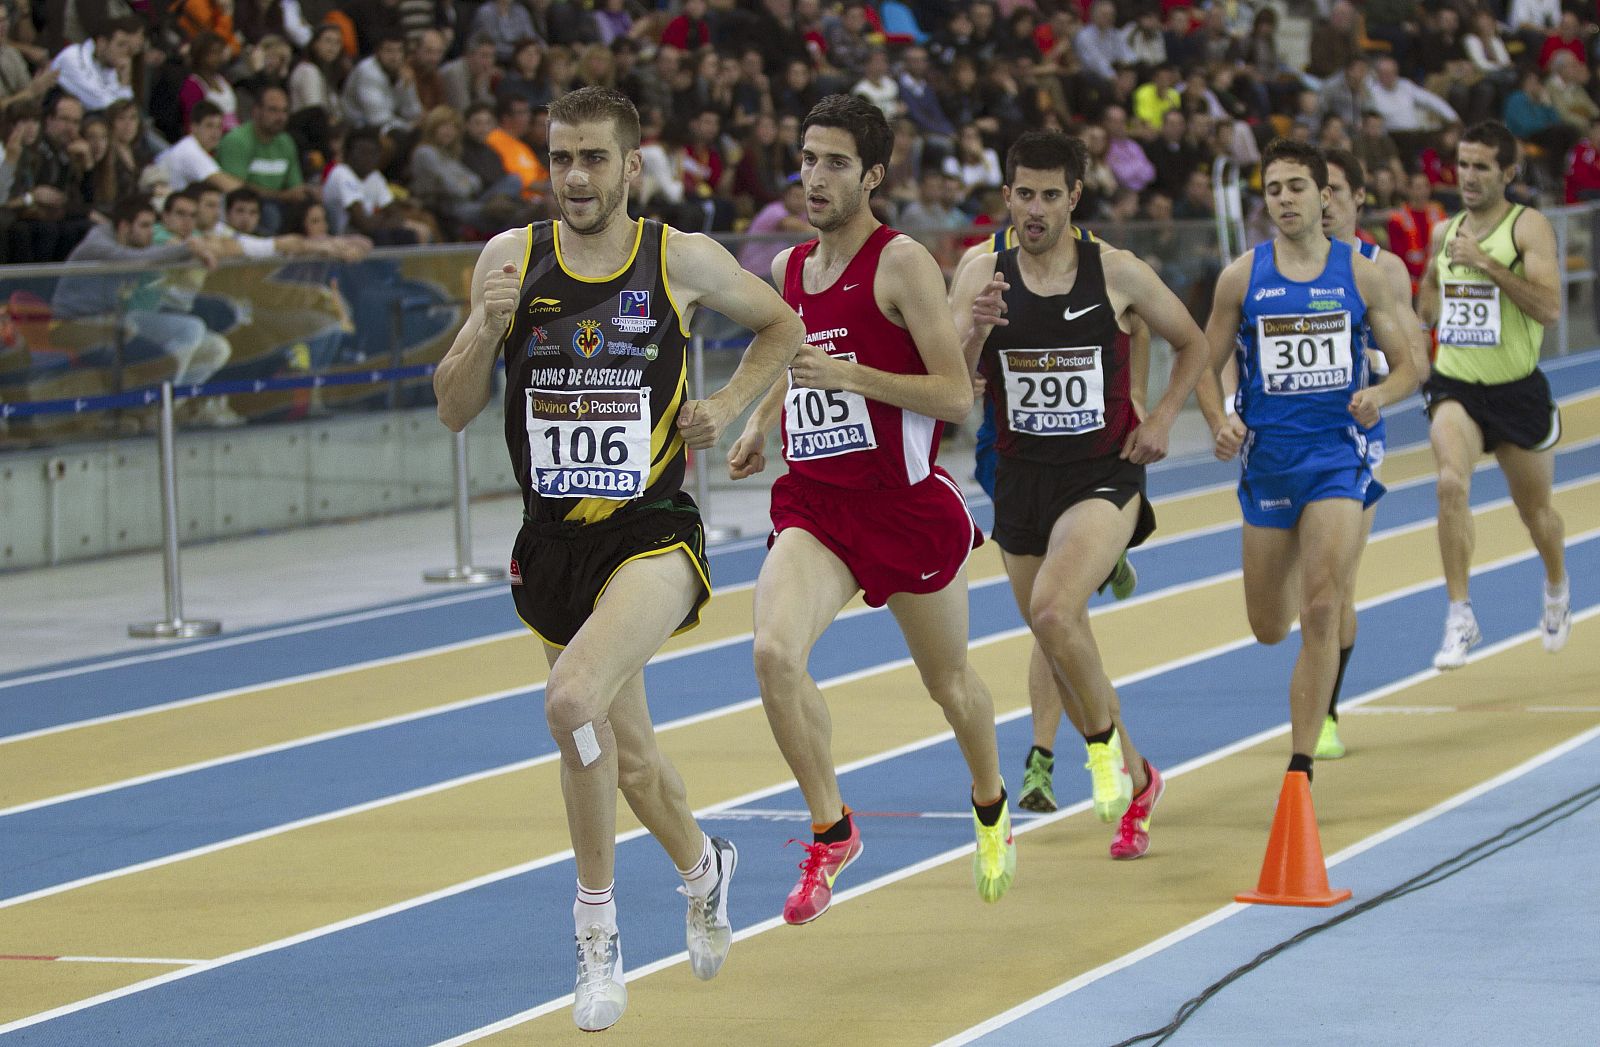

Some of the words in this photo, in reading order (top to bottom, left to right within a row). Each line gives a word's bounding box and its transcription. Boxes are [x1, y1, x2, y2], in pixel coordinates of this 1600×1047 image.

[1265, 287, 1287, 298] asics
[529, 306, 561, 314] LI-NING
[1446, 302, 1489, 326] 239
[1311, 319, 1345, 331] Pastora
[1009, 357, 1037, 368] Divina
[1057, 355, 1094, 367] Pastora
[1275, 338, 1336, 369] 301
[531, 367, 566, 386] PLAYAS
[567, 368, 583, 386] DE
[584, 368, 643, 387] CASTELLON
[1017, 375, 1088, 409] 290
[533, 399, 568, 414] Divina
[590, 400, 639, 414] Pastora
[792, 389, 850, 429] 105
[543, 425, 629, 466] 106
